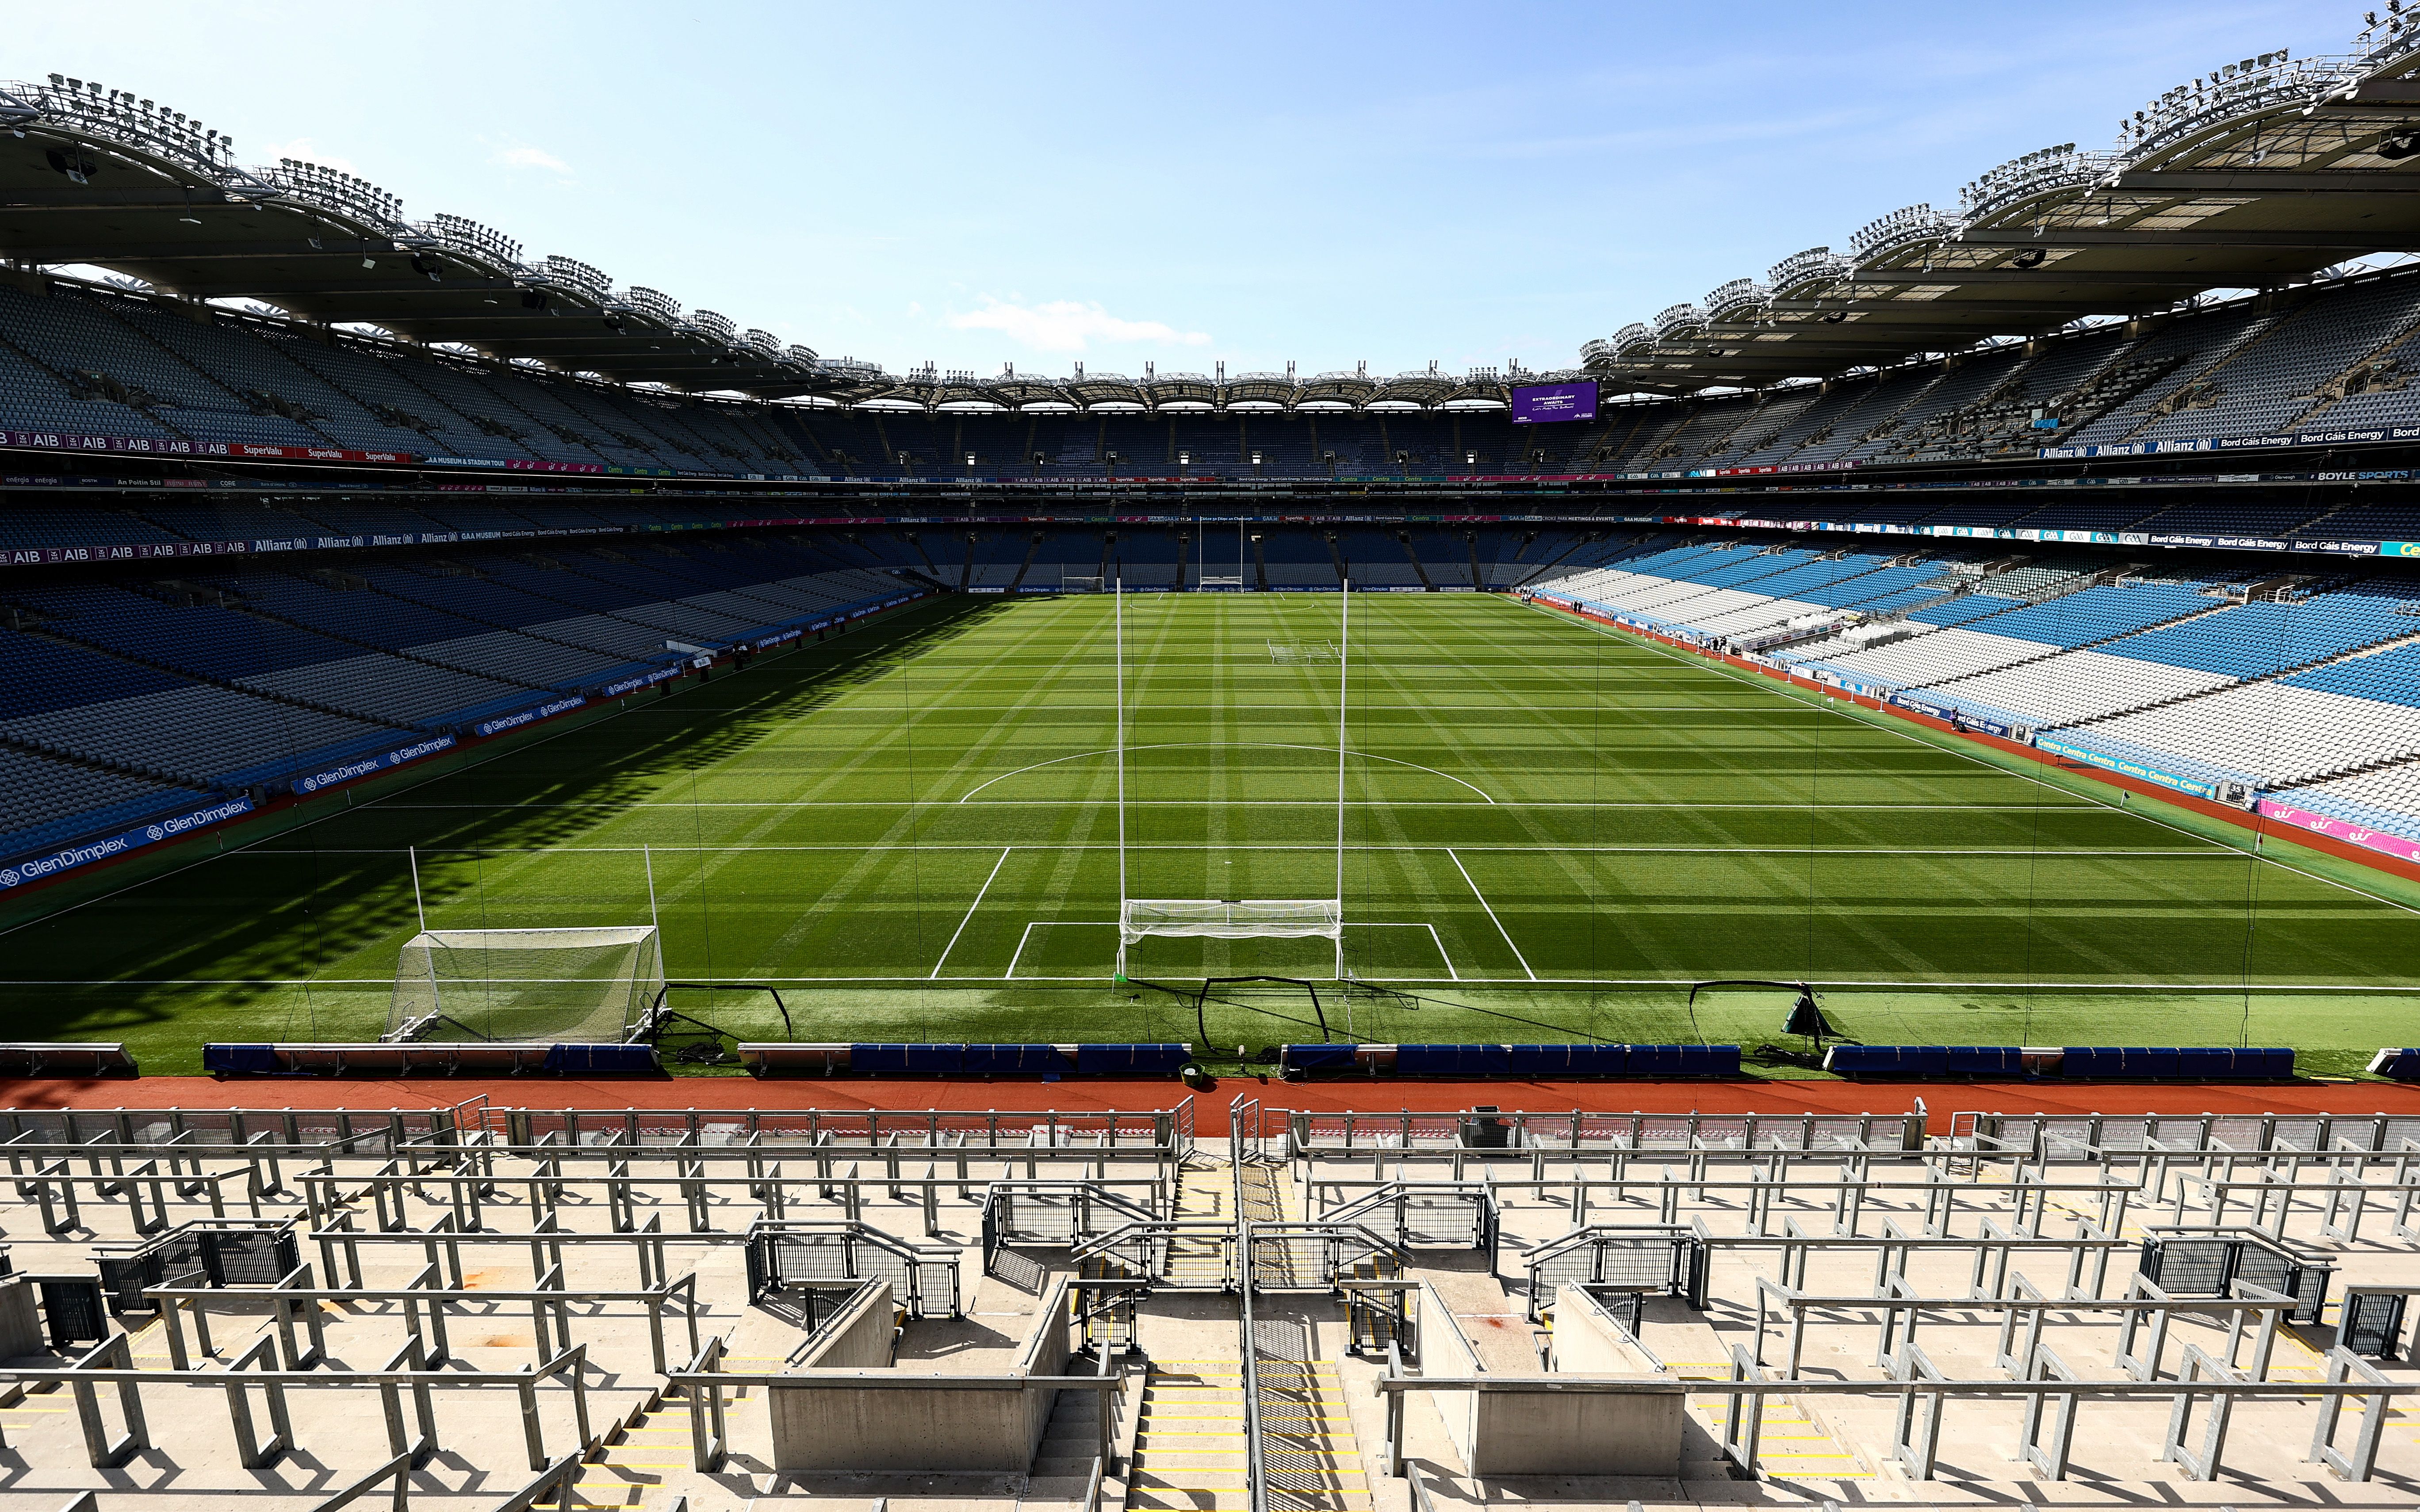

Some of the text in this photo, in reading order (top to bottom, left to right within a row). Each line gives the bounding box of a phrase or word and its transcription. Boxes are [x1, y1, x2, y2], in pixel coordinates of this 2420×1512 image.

[2301, 431, 2384, 443] Bord Gáis Energy
[2393, 428, 2420, 437] Bord
[33, 434, 59, 447] AIB
[83, 437, 106, 448] AIB
[128, 439, 149, 450] AIB
[2261, 437, 2293, 445] Energy
[170, 442, 190, 452] AIB
[208, 443, 227, 454] AIB
[244, 445, 282, 456] SuperValu
[2096, 445, 2130, 456] Allianz
[2155, 441, 2194, 452] Allianz
[308, 449, 342, 459] SuperValu
[365, 452, 395, 462] SuperValu
[2043, 448, 2073, 458] Allianz
[2318, 472, 2356, 481] BOYLE
[318, 538, 351, 548] Allianz
[373, 535, 402, 546] Allianz
[421, 534, 447, 543] Allianz
[2169, 536, 2184, 544] Gáis
[2185, 537, 2213, 547] Energy
[2238, 538, 2256, 547] Gáis
[2257, 539, 2288, 550] Energy
[153, 546, 174, 556] AIB
[193, 544, 212, 554] AIB
[227, 542, 245, 552] AIB
[256, 540, 292, 551] Allianz
[2295, 541, 2378, 554] Bord Gáis Energy
[14, 551, 40, 563] AIB
[64, 549, 88, 561] AIB
[111, 547, 133, 558] AIB
[653, 665, 678, 680] GlenDimplex
[614, 678, 643, 692] GlenDimplex
[547, 696, 583, 714] GlenDimplex
[1897, 697, 1909, 706] Bord
[1922, 704, 1940, 716] Energy
[492, 712, 534, 730] GlenDimplex
[400, 736, 452, 759] GlenDimplex
[2038, 739, 2060, 751] Centra
[2063, 746, 2087, 759] Centra
[2088, 753, 2115, 766] Centra
[2118, 762, 2146, 775] Centra
[2149, 771, 2178, 785] Centra
[316, 760, 379, 785] GlenDimplex
[163, 801, 248, 832] GlenDimplex
[2274, 807, 2295, 819] eir
[2310, 817, 2332, 829] eir
[2349, 829, 2373, 840] eir
[21, 837, 128, 877] GlenDimplex
